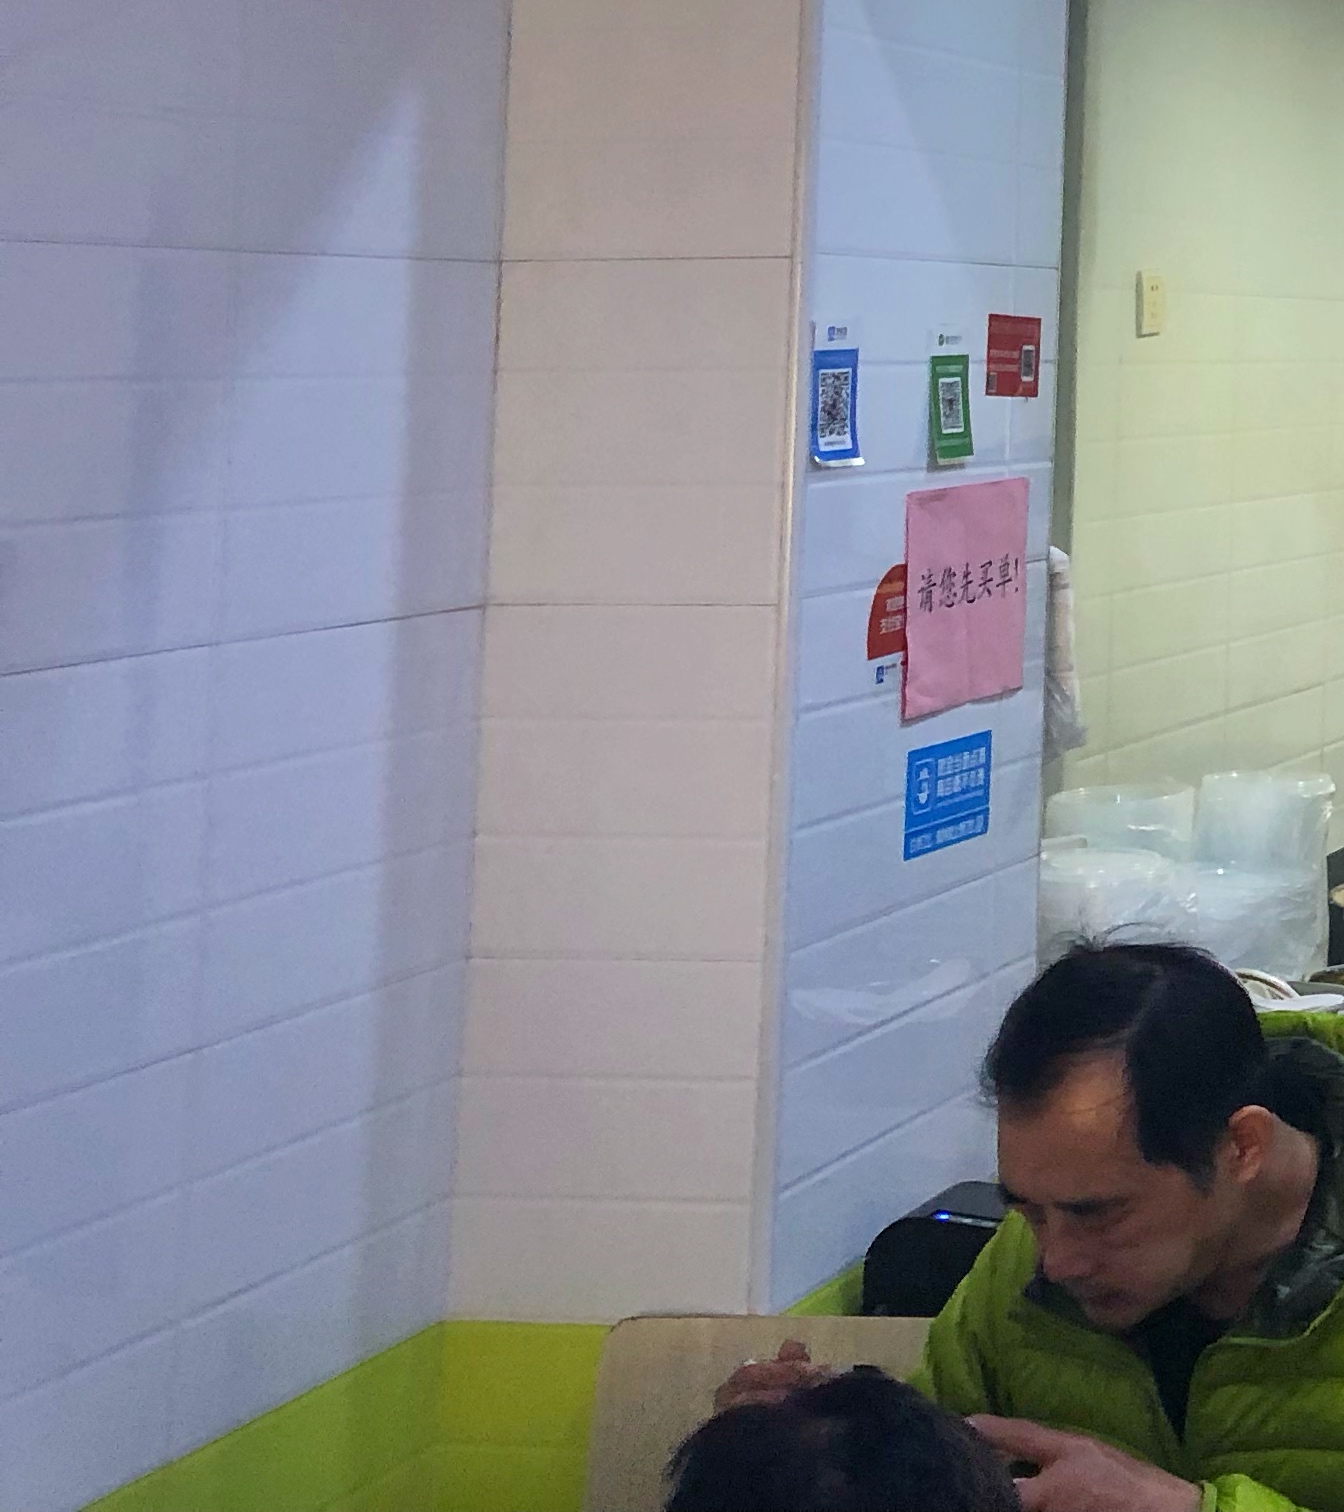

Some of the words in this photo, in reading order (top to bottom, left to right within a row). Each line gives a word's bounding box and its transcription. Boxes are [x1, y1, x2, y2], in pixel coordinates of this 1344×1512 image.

[917, 552, 1019, 613] 请您先买单！
